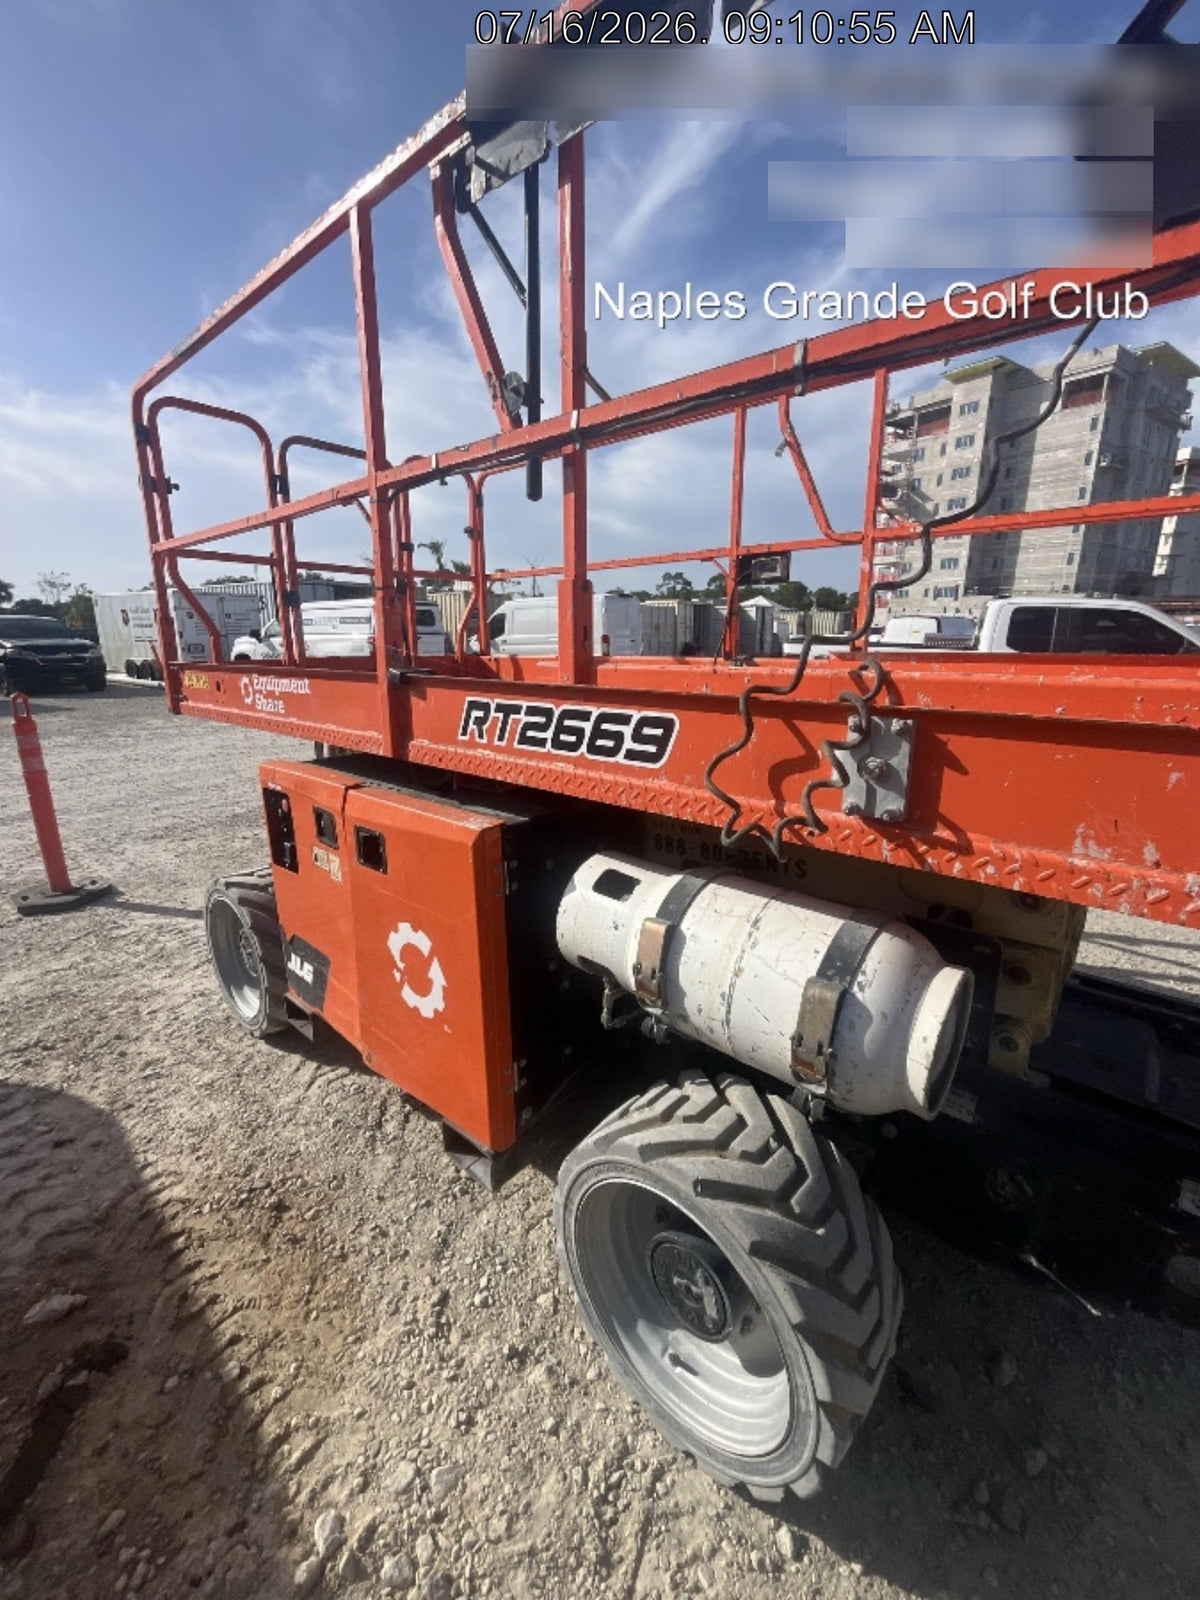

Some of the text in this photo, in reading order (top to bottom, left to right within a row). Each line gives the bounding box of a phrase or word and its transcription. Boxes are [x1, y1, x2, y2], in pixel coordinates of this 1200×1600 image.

[252, 674, 310, 694] Equipment
[254, 694, 285, 713] Share
[458, 697, 679, 768] RT2669
